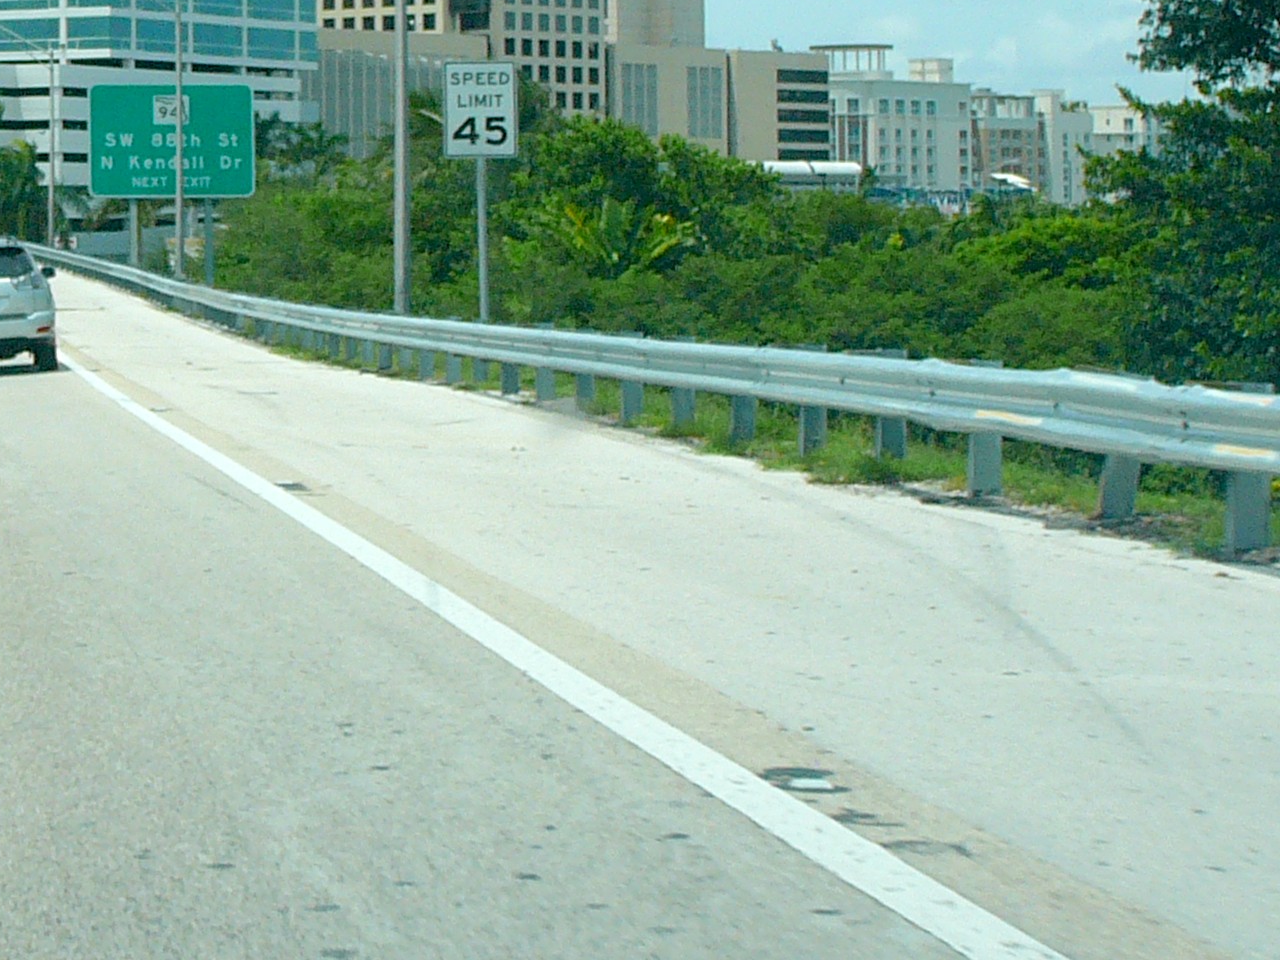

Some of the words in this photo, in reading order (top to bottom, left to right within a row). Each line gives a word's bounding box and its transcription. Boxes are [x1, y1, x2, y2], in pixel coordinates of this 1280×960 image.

[450, 71, 511, 86] SPEED
[456, 93, 504, 109] LIMIT
[452, 116, 508, 146] 45
[104, 132, 134, 148] SW
[151, 132, 201, 148] 88th
[218, 132, 239, 148] St
[100, 155, 114, 170] N
[128, 155, 205, 170] Kendall
[219, 155, 243, 170] Dr
[131, 176, 168, 188] NEXT
[181, 176, 212, 188] EXIT
